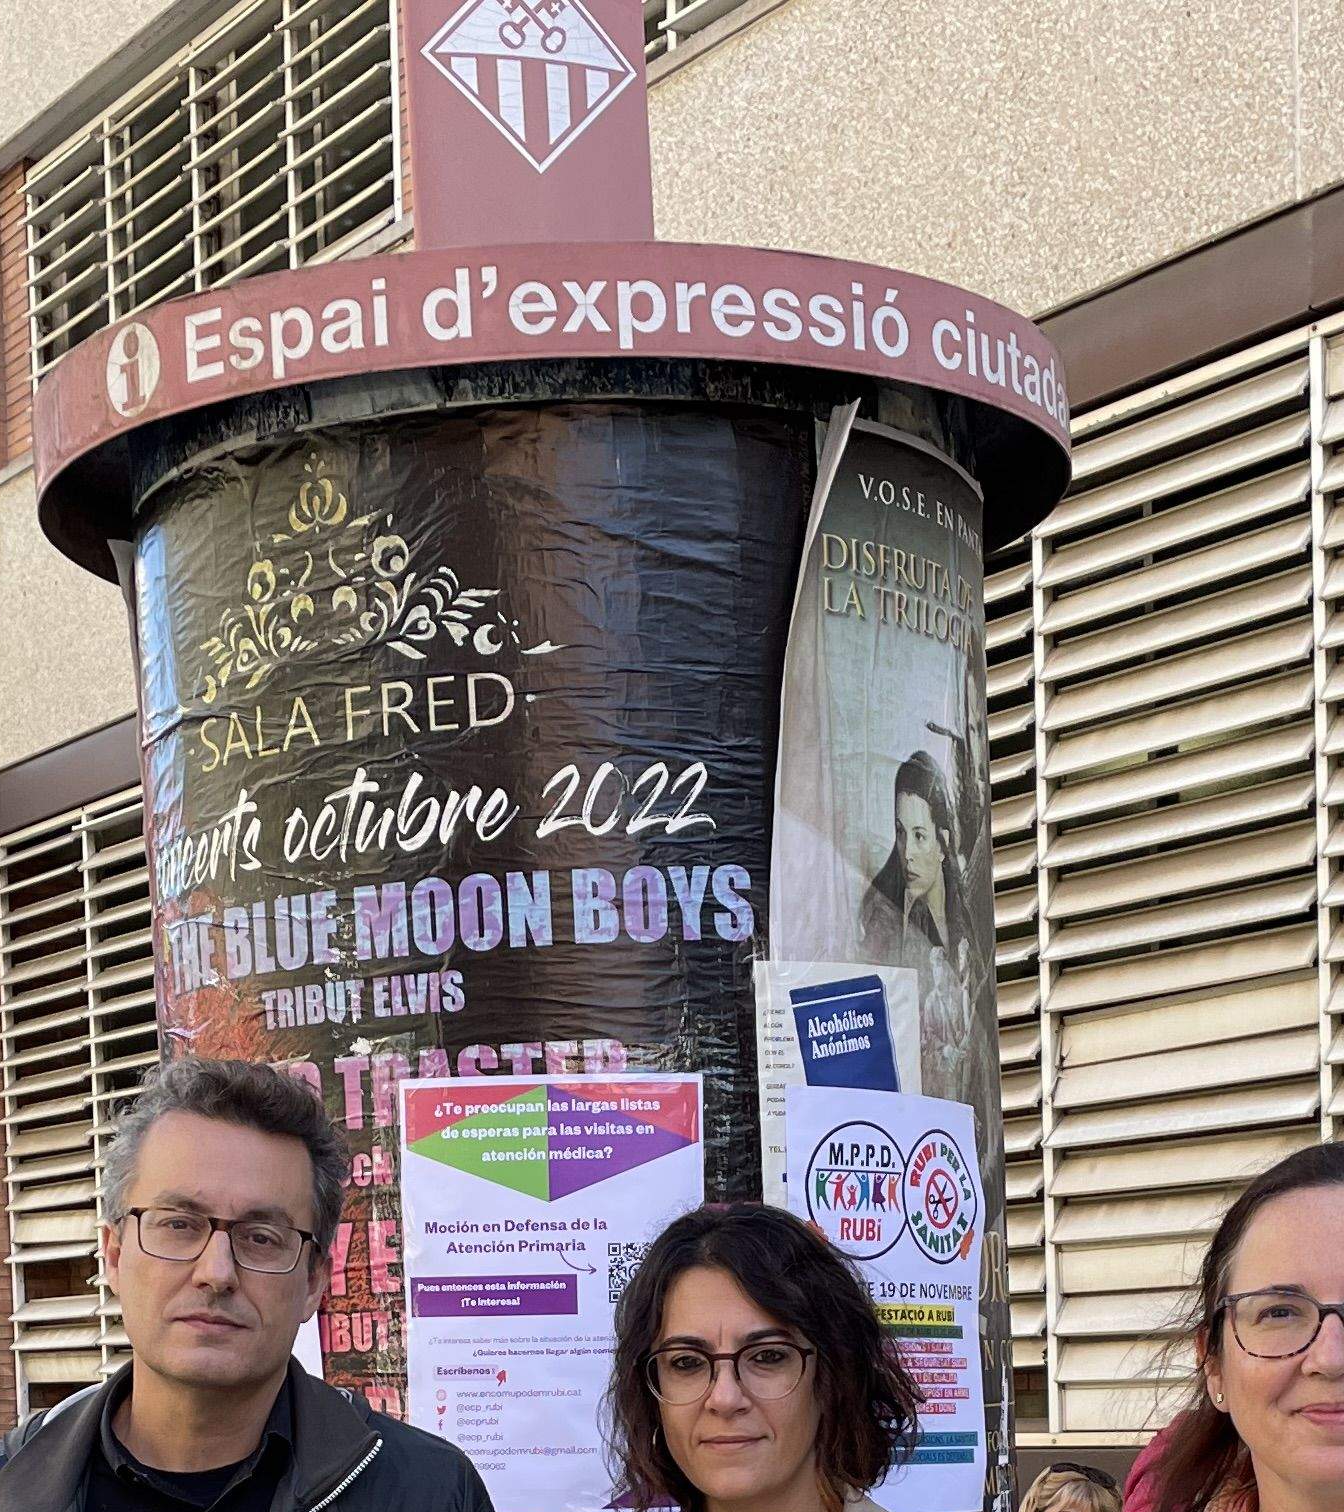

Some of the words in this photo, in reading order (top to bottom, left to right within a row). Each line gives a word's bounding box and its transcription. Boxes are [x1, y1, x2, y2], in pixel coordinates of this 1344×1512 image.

[185, 277, 389, 383] Espai
[822, 532, 954, 607] DISFRUTA
[823, 576, 866, 621] LA
[200, 697, 321, 773] SALA
[344, 672, 515, 741] FRED
[283, 767, 522, 865] octubre
[536, 760, 717, 840] 2022
[164, 912, 220, 996] THE
[223, 889, 340, 980] BLUE
[353, 869, 553, 962] MOON
[571, 864, 756, 946] BOYS
[262, 979, 365, 1031] TRIBUT
[373, 970, 466, 1019] ELVIS
[807, 1009, 875, 1039] Alcohólicos
[811, 1033, 871, 1060] Anónimos
[434, 1102, 462, 1118] ¿Te
[465, 1102, 545, 1117] preocupan
[547, 1099, 568, 1112] las
[571, 1098, 618, 1114] largas
[620, 1098, 661, 1112] listas
[441, 1127, 458, 1139] de
[460, 1126, 519, 1140] esperas
[522, 1126, 558, 1140] para
[559, 1123, 582, 1136] las
[584, 1122, 633, 1136] visitas
[636, 1125, 655, 1135] en
[481, 1148, 546, 1162] atención
[549, 1146, 613, 1161] médica?
[829, 1142, 896, 1169] M.P.P.D.
[424, 1220, 479, 1235] Moción
[482, 1222, 501, 1233] en
[504, 1219, 567, 1232] Defensa
[570, 1219, 590, 1231] de
[593, 1218, 608, 1231] la
[911, 1210, 969, 1254] SANITAT
[446, 1241, 515, 1254] Atención
[518, 1239, 586, 1252] Primaria
[417, 1282, 440, 1292] Pues
[441, 1282, 484, 1292] entonces
[484, 1282, 506, 1292] esta
[507, 1280, 567, 1291] información
[879, 1281, 896, 1298] 19
[900, 1281, 916, 1299] DE
[919, 1283, 973, 1301] NOVEMBRE
[462, 1445, 598, 1457] ncomupodemrubi@gmail.com
